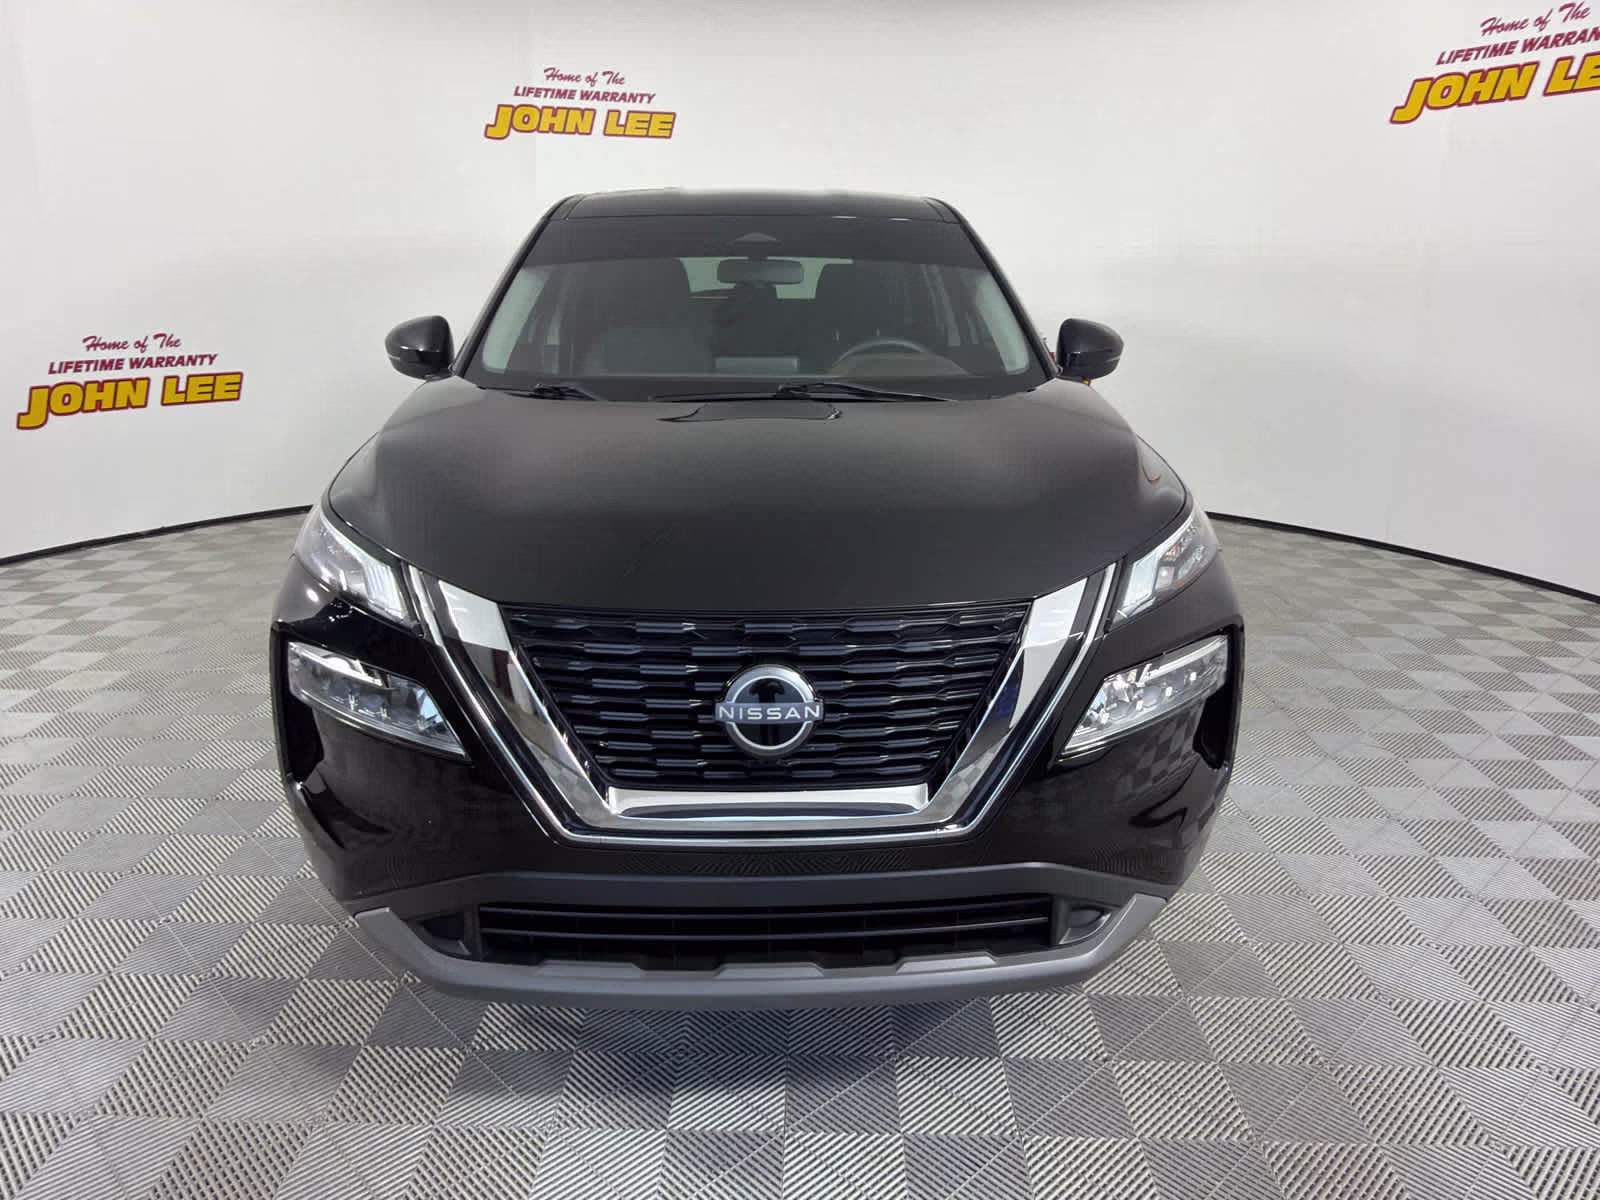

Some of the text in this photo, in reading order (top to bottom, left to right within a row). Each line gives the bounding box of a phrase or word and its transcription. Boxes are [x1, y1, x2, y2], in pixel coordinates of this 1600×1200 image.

[1480, 1, 1591, 36] Home of The
[1436, 40, 1519, 65] LIFETIME
[543, 67, 626, 87] Home of The
[513, 86, 656, 104] LIFETIME WARRANTY
[1389, 60, 1540, 124] JOHN
[484, 104, 677, 140] JOHN LEE
[82, 333, 182, 353] Home of The
[48, 353, 218, 375] LIFETIME WARRANTY
[16, 372, 244, 430] JOHN LEE
[719, 705, 820, 720] NISSAN
